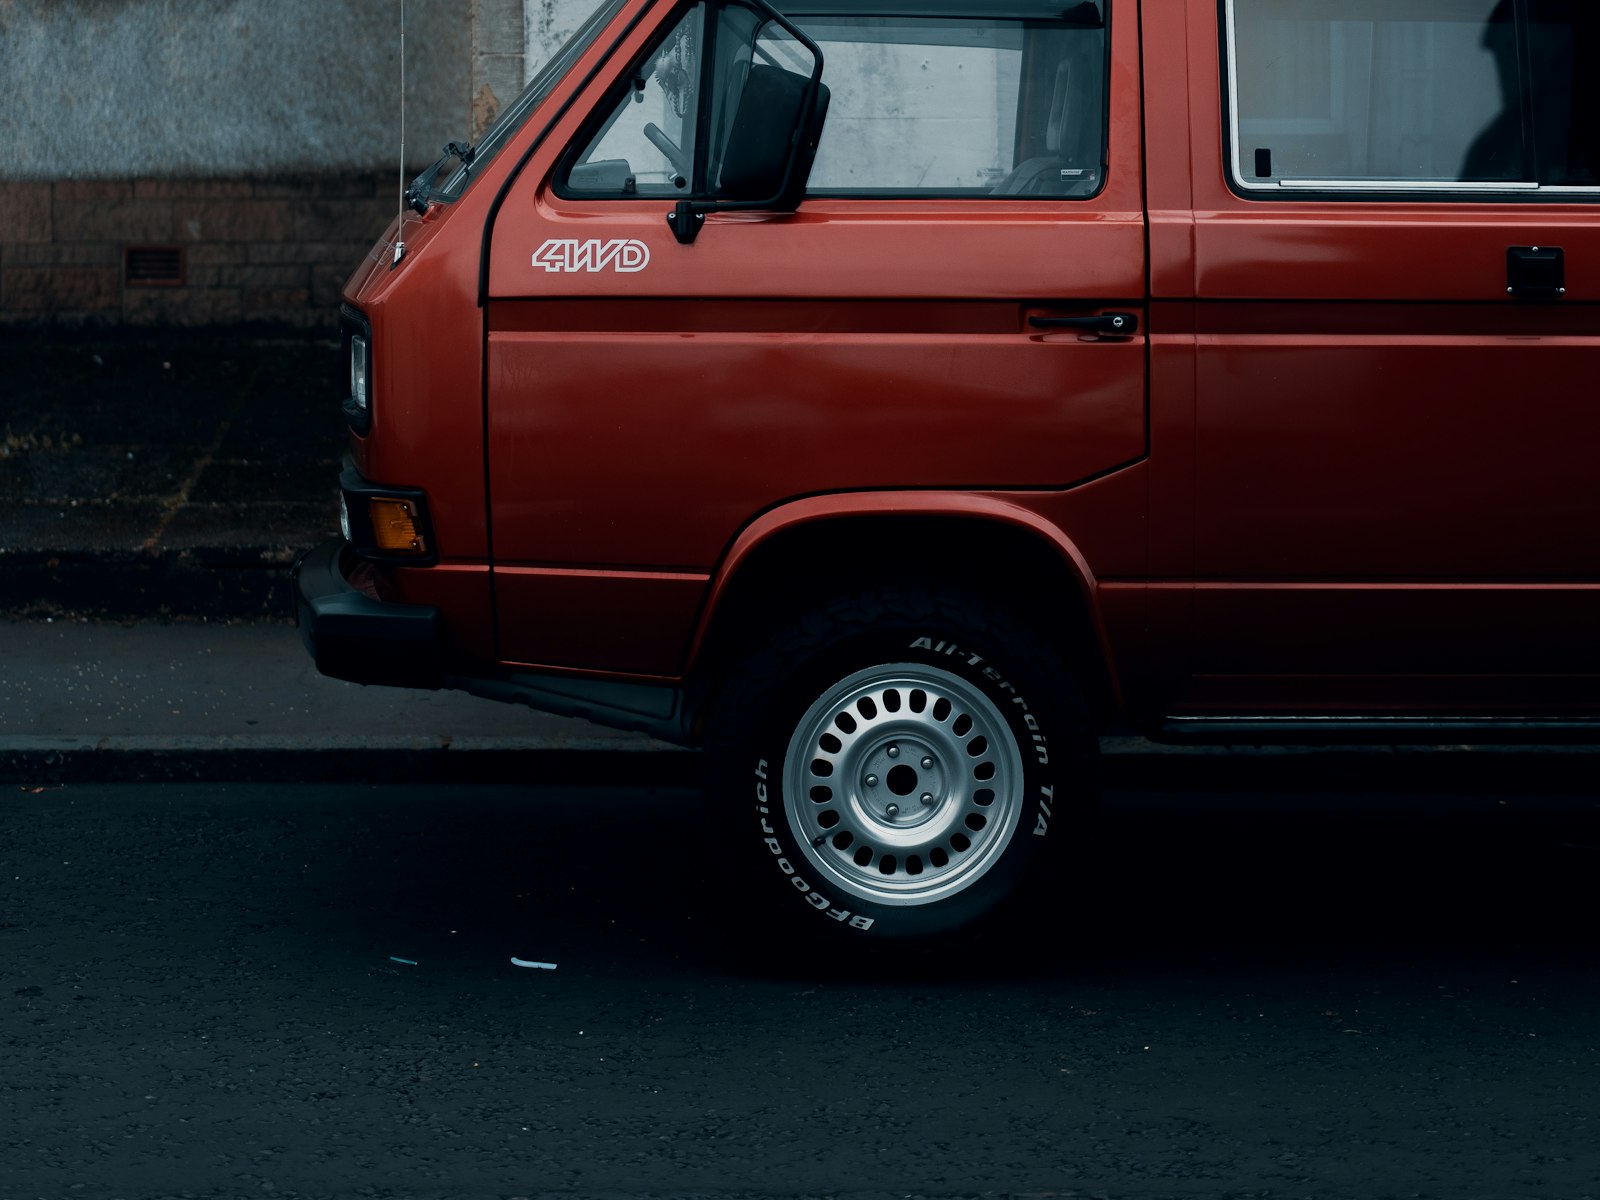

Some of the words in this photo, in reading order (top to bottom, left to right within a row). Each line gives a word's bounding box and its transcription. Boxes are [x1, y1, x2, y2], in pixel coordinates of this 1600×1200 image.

[532, 239, 650, 272] 4WD
[909, 636, 1049, 765] All-Terrain
[1032, 784, 1054, 836] T/A
[754, 759, 875, 931] BFGoodrich
